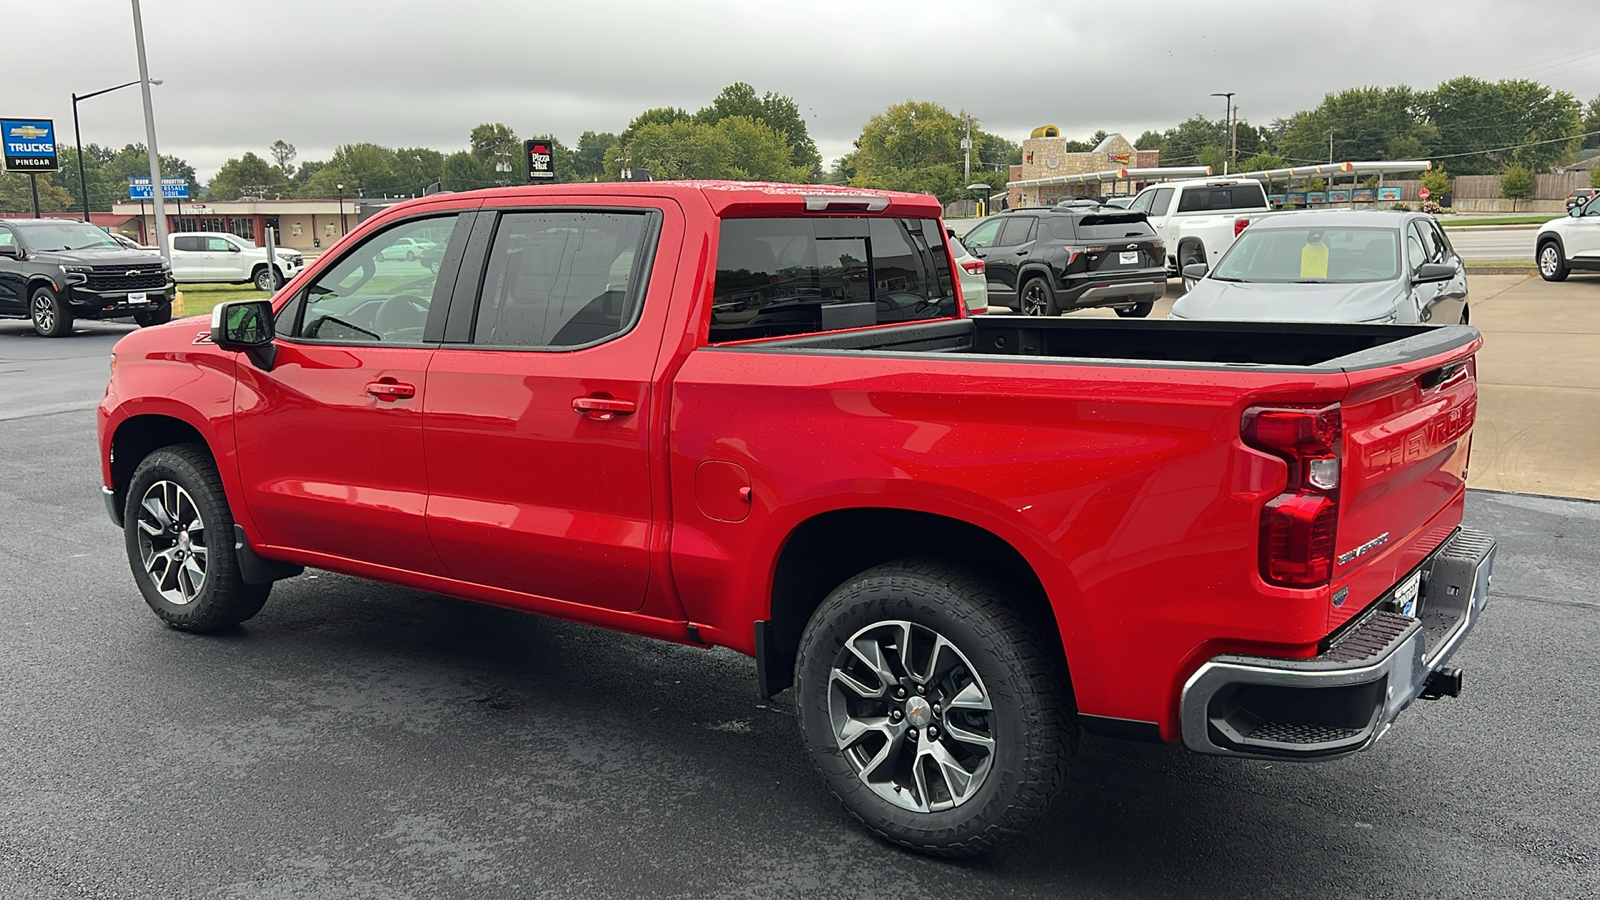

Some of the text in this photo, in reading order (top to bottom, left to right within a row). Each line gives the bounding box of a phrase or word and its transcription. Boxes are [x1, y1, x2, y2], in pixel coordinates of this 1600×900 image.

[8, 143, 54, 152] TRUCKS
[532, 153, 550, 163] Pizza
[533, 161, 547, 170] Hut
[1365, 402, 1475, 479] CHEVROLE
